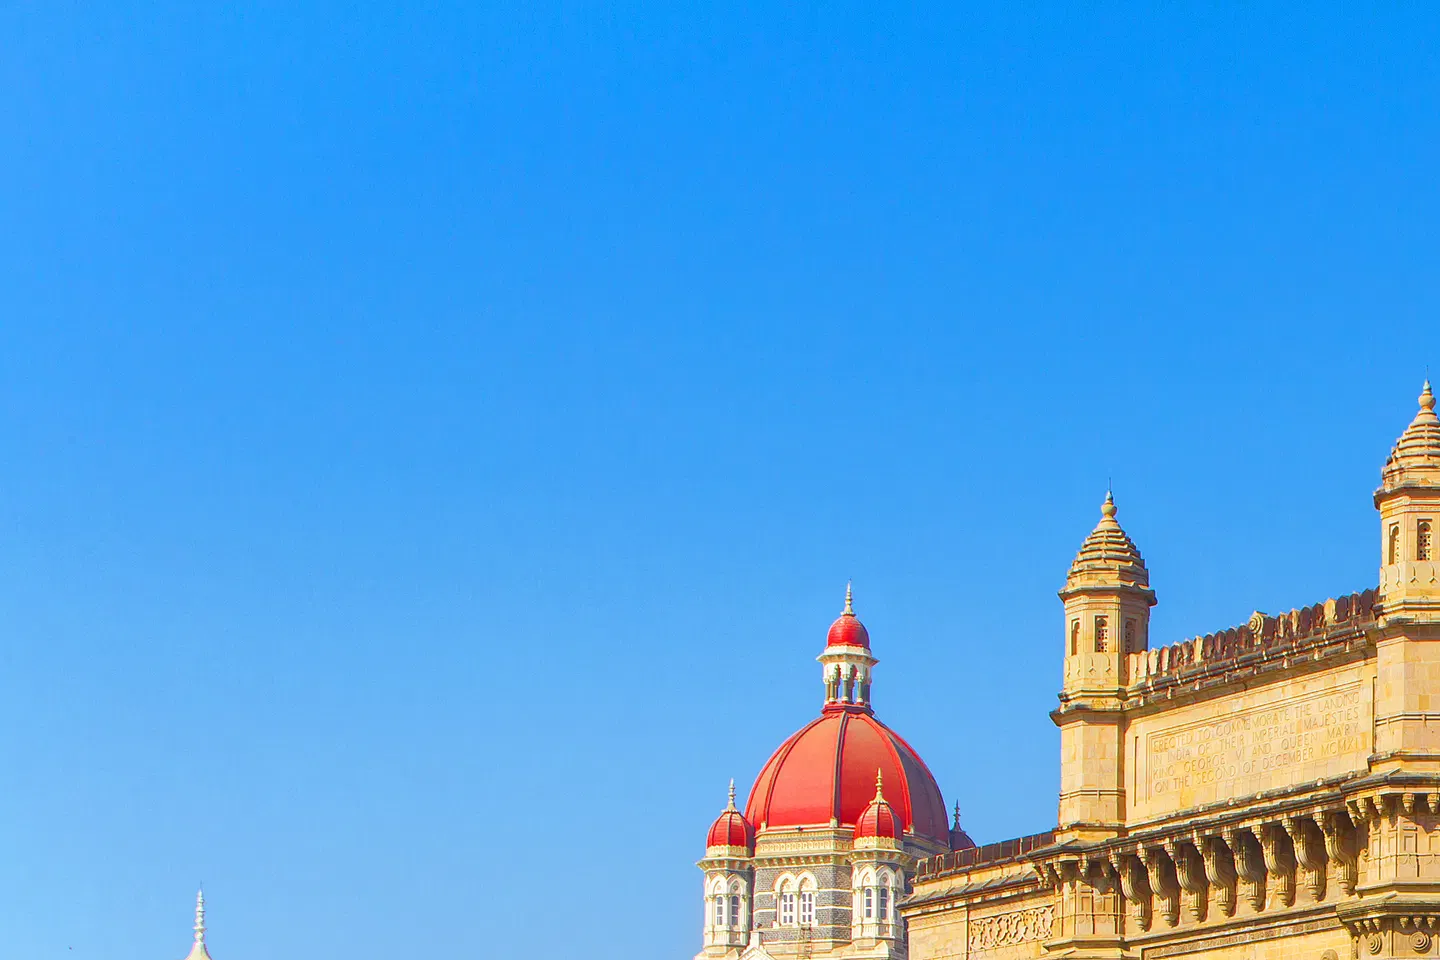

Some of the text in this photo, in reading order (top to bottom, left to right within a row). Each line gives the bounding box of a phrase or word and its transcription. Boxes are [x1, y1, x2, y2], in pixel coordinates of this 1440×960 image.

[1153, 691, 1360, 753] ERECTED TO COMMEMORATE THE LANDING
[1153, 706, 1359, 767] IN INDIA OF THEIR IMPERIAL MAJESTIES
[1153, 764, 1175, 780] KING
[1184, 753, 1225, 773] GEORGE
[1252, 742, 1271, 757] AND
[1281, 732, 1318, 751] QUEEN
[1327, 722, 1359, 739] MARY
[1154, 737, 1358, 794] ON THE SECOND OF DECEMBER MCMXI
